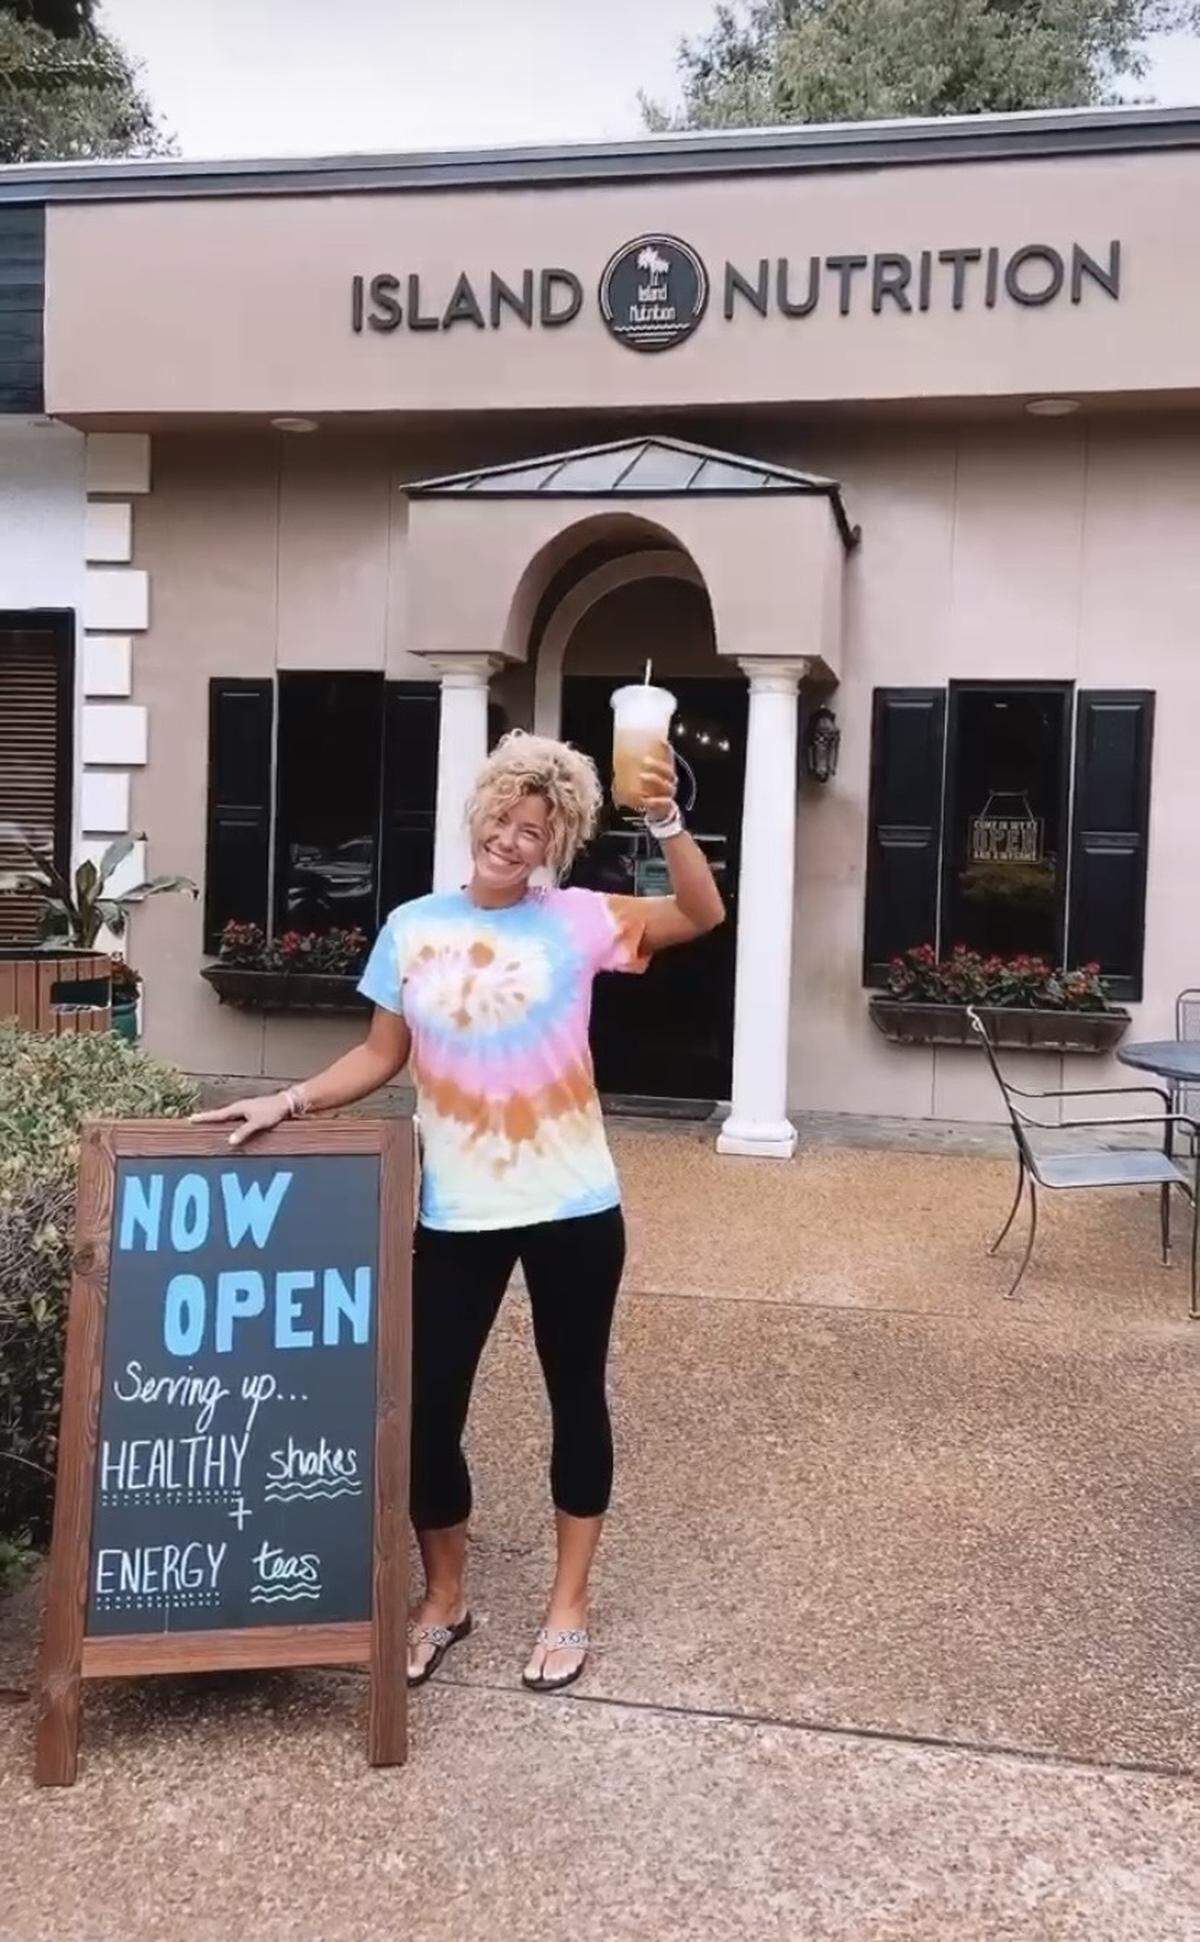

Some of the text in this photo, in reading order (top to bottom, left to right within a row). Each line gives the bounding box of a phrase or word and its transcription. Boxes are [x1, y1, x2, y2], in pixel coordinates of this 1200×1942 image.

[352, 240, 1120, 333] ISLAND NUTRITION
[972, 829, 1038, 853] OPEN
[119, 1171, 294, 1252] NOW
[163, 1266, 372, 1357] OPEN
[113, 1360, 231, 1434] Serving
[101, 1434, 358, 1491] HEALTHY shakes
[96, 1539, 321, 1595] ENERGY teas
